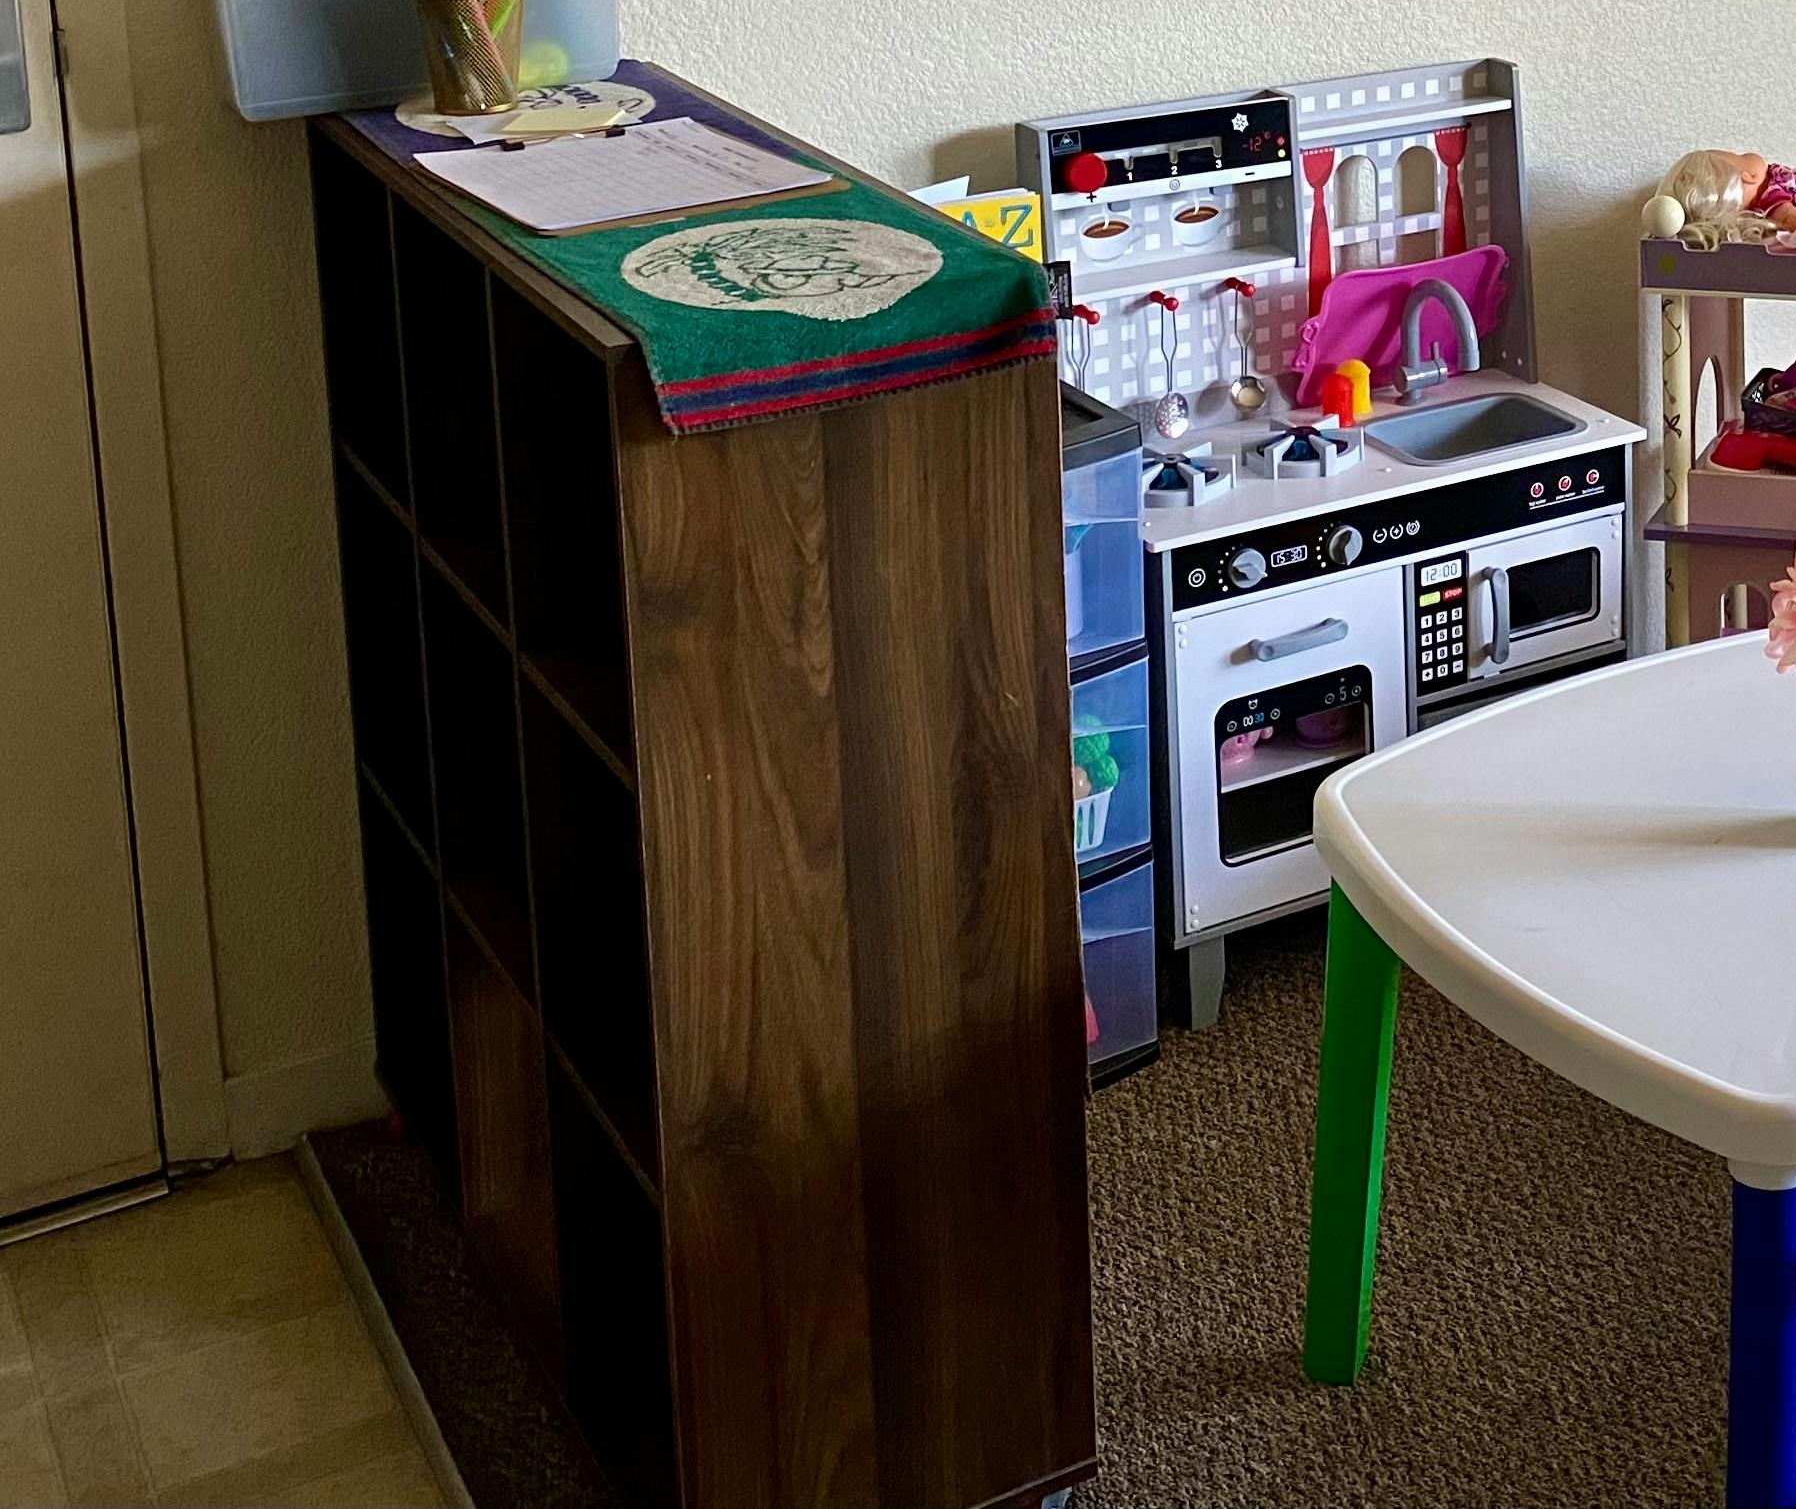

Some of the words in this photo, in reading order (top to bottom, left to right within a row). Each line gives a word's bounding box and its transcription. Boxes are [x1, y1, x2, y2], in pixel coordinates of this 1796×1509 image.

[1127, 171, 1133, 181] 1
[1171, 165, 1178, 175] 2
[1215, 159, 1222, 169] 3
[1426, 563, 1458, 582] 12:00
